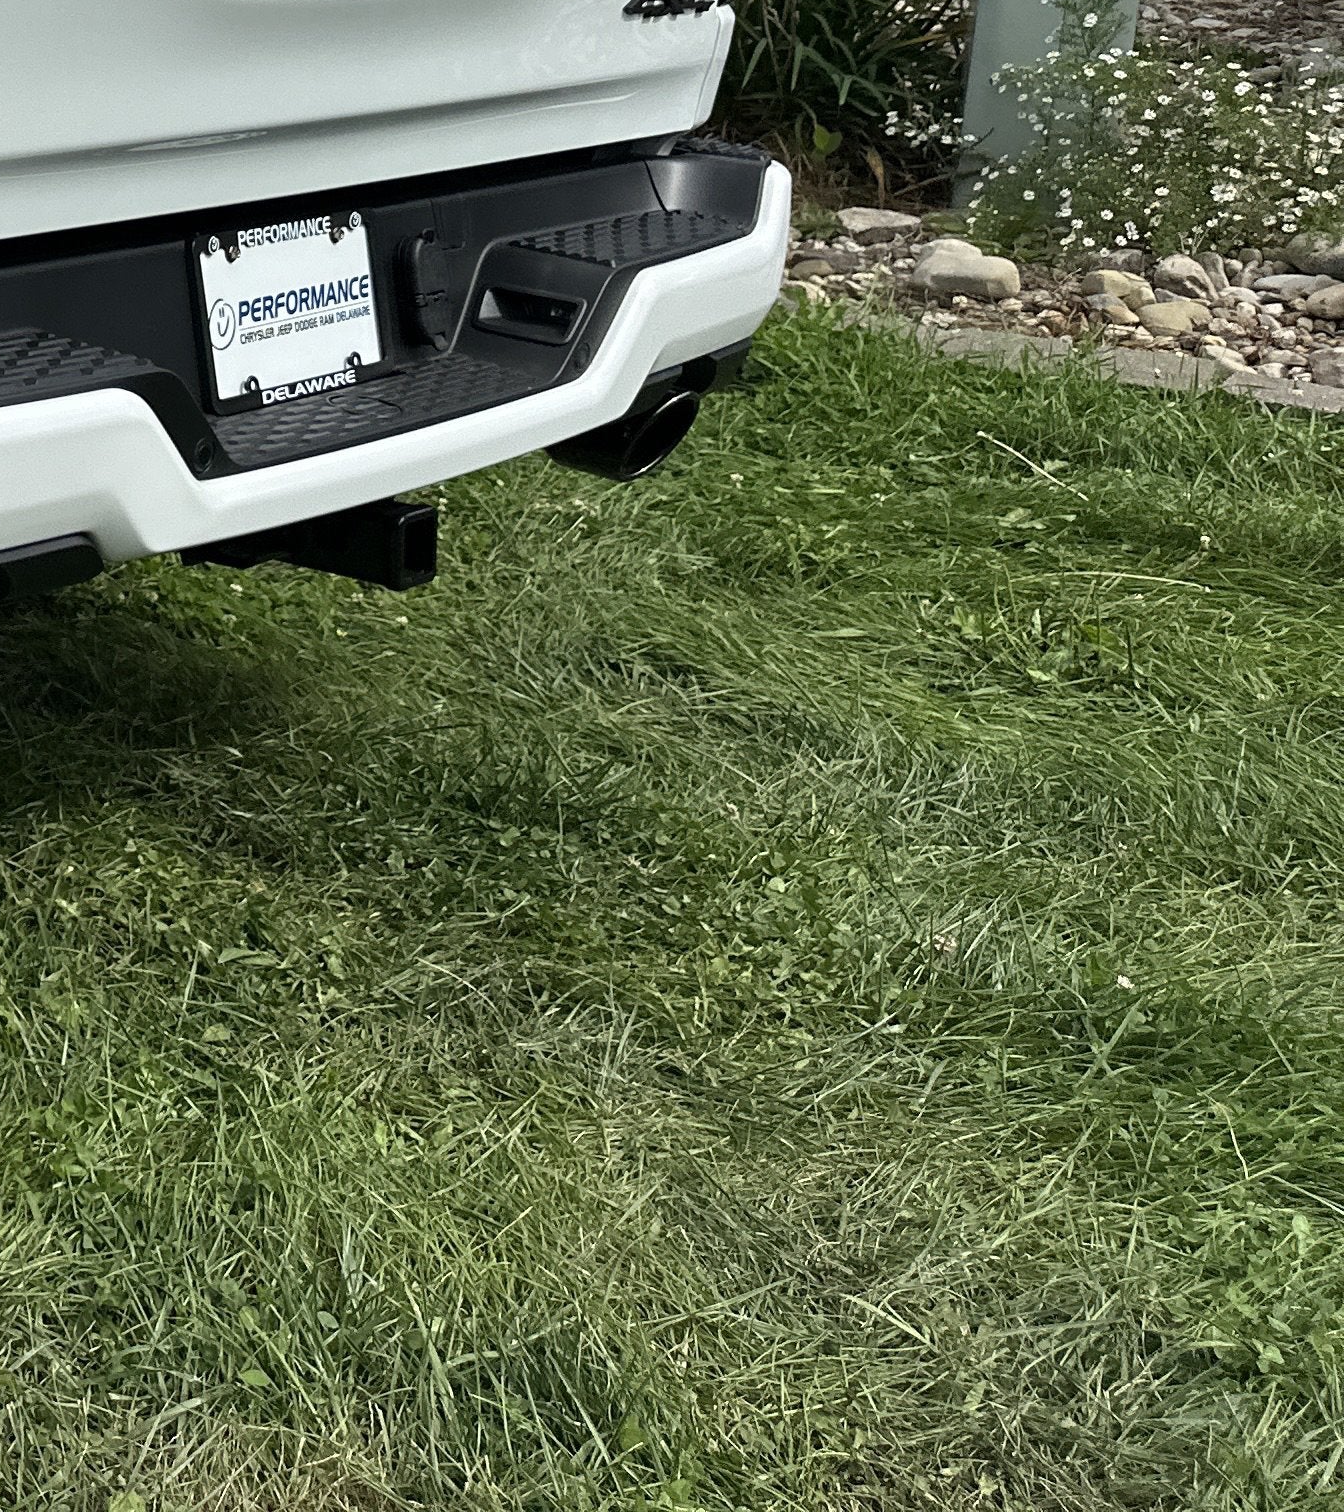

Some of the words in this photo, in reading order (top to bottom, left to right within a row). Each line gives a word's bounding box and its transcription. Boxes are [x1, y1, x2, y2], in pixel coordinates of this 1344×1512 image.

[237, 215, 332, 250] PERFORMANCE
[238, 274, 369, 326] PERFORMANCE
[240, 327, 275, 345] CHRYSLER
[276, 323, 293, 337] JEEP
[319, 313, 335, 327] RAM
[262, 369, 357, 405] DELAWARE
